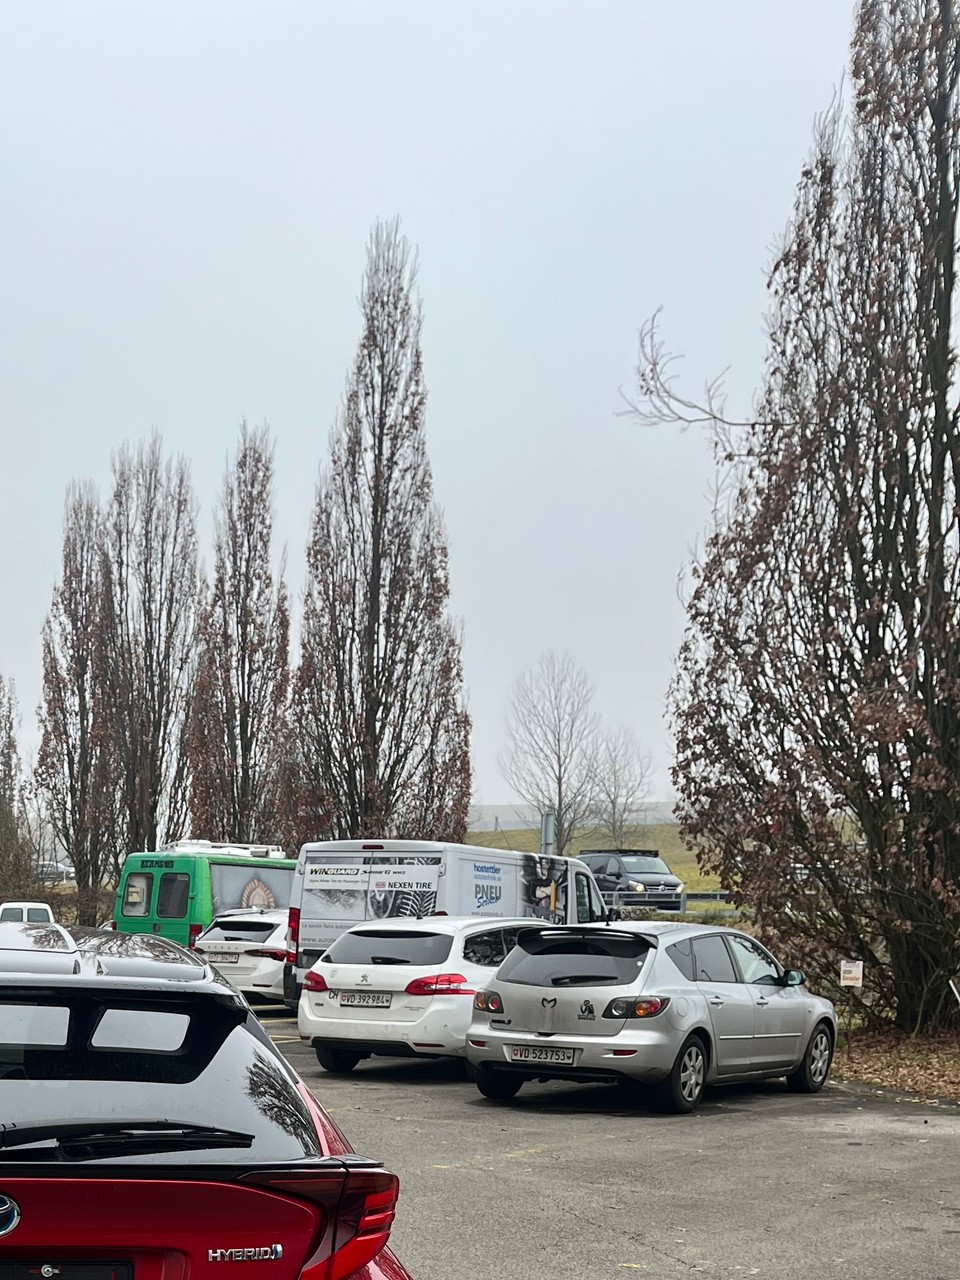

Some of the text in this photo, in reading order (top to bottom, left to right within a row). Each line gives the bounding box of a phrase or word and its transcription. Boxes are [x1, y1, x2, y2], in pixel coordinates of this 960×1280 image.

[473, 863, 502, 875] hostettler
[388, 881, 414, 889] NEXEN
[415, 881, 433, 890] TIRE
[474, 884, 502, 901] PNEU
[328, 990, 340, 1000] CH
[208, 1247, 272, 1262] HYBRID
